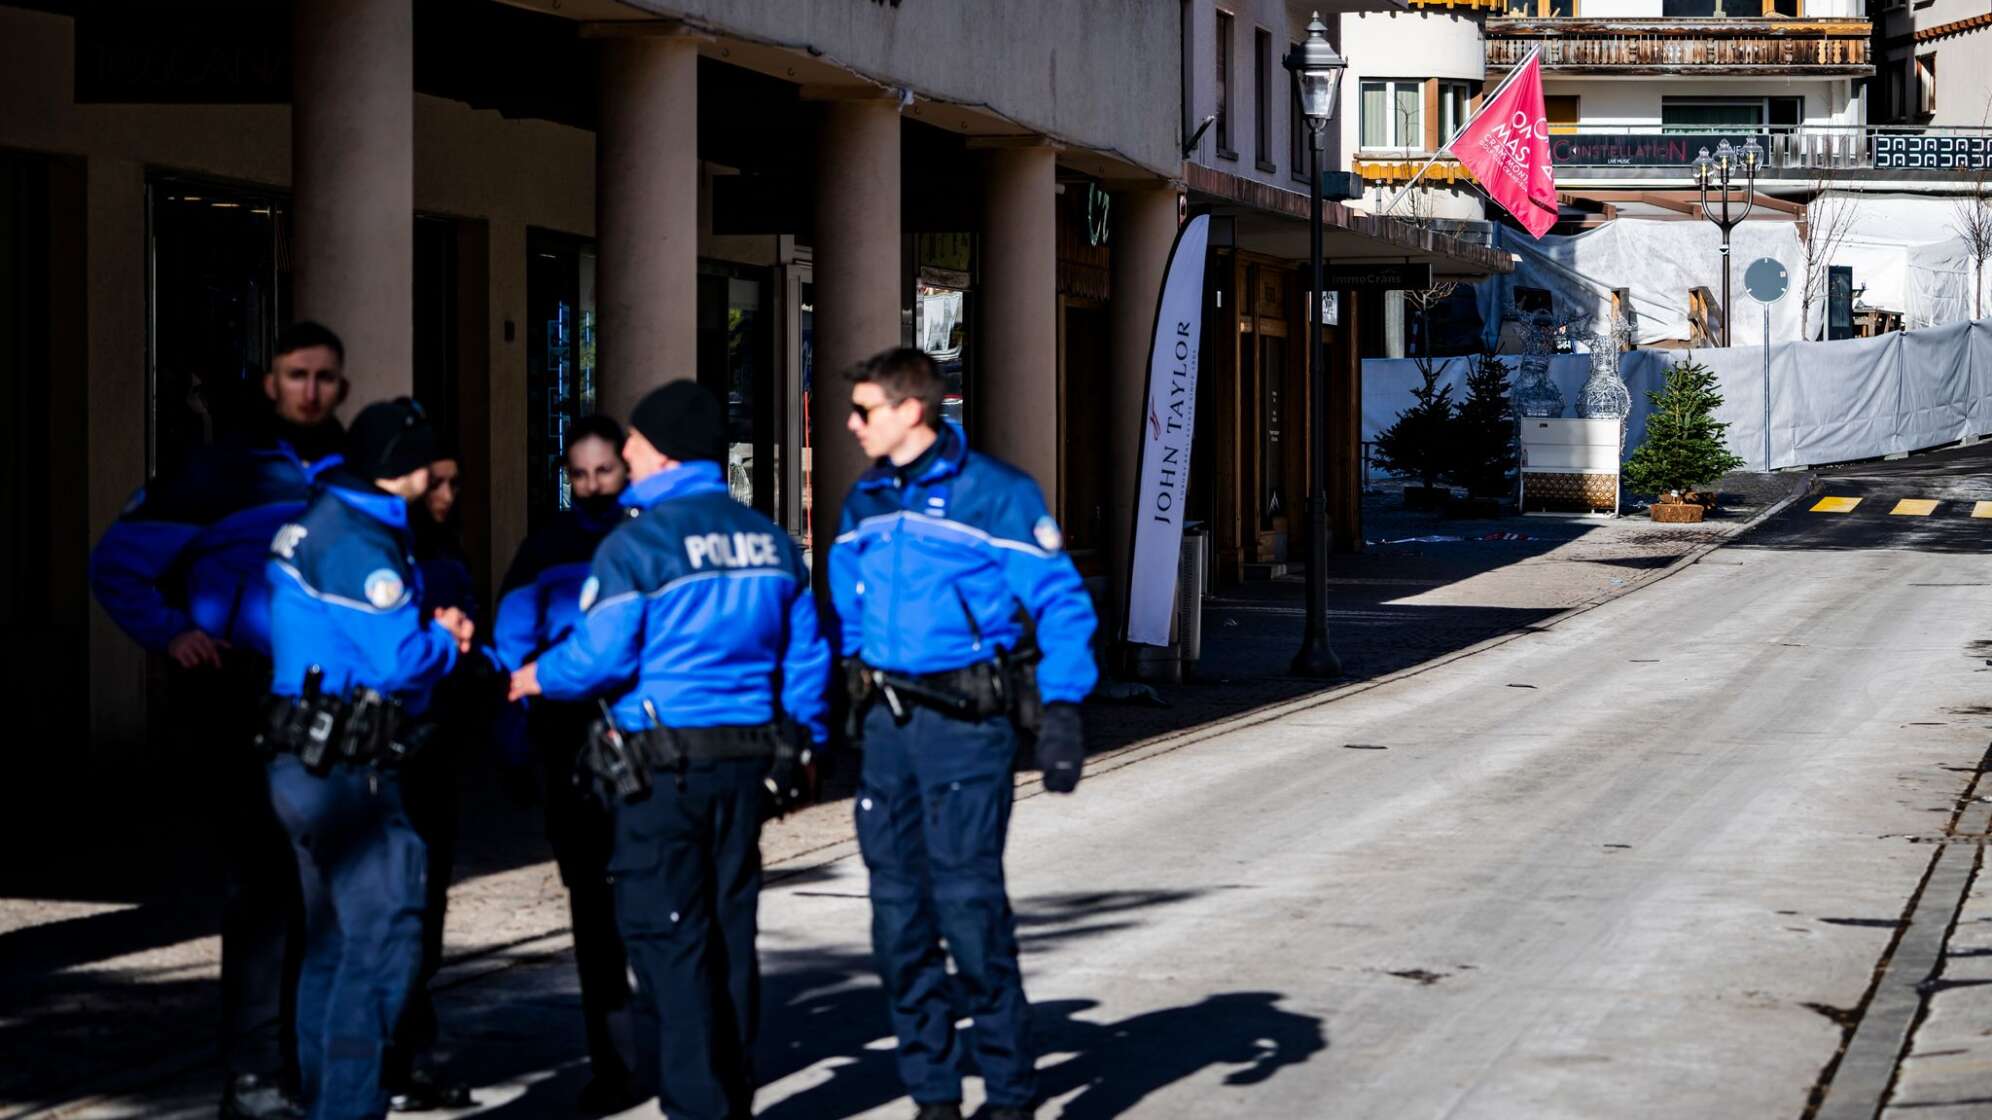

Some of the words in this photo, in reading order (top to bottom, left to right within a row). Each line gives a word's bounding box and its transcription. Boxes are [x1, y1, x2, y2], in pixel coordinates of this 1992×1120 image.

[1166, 321, 1192, 434] TAYLOR
[1154, 446, 1179, 523] JOHN
[684, 531, 781, 569] POLICE
